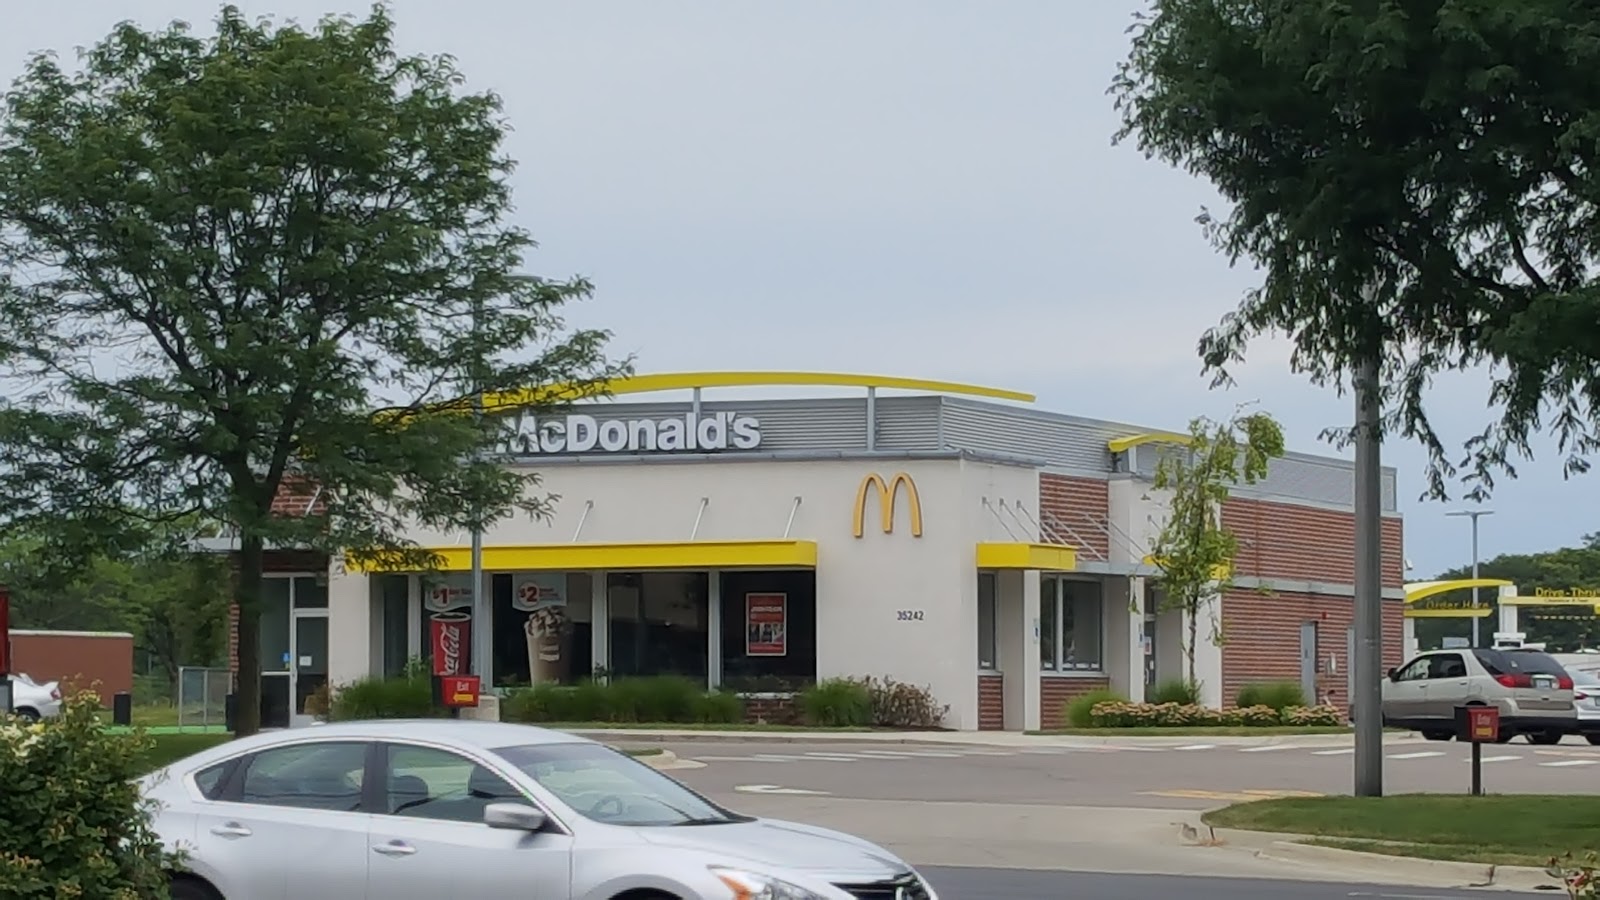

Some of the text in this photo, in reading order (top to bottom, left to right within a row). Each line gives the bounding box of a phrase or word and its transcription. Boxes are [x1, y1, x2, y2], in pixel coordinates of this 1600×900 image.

[495, 411, 762, 453] McDonald's
[519, 586, 537, 602] $2
[896, 610, 924, 621] 35242
